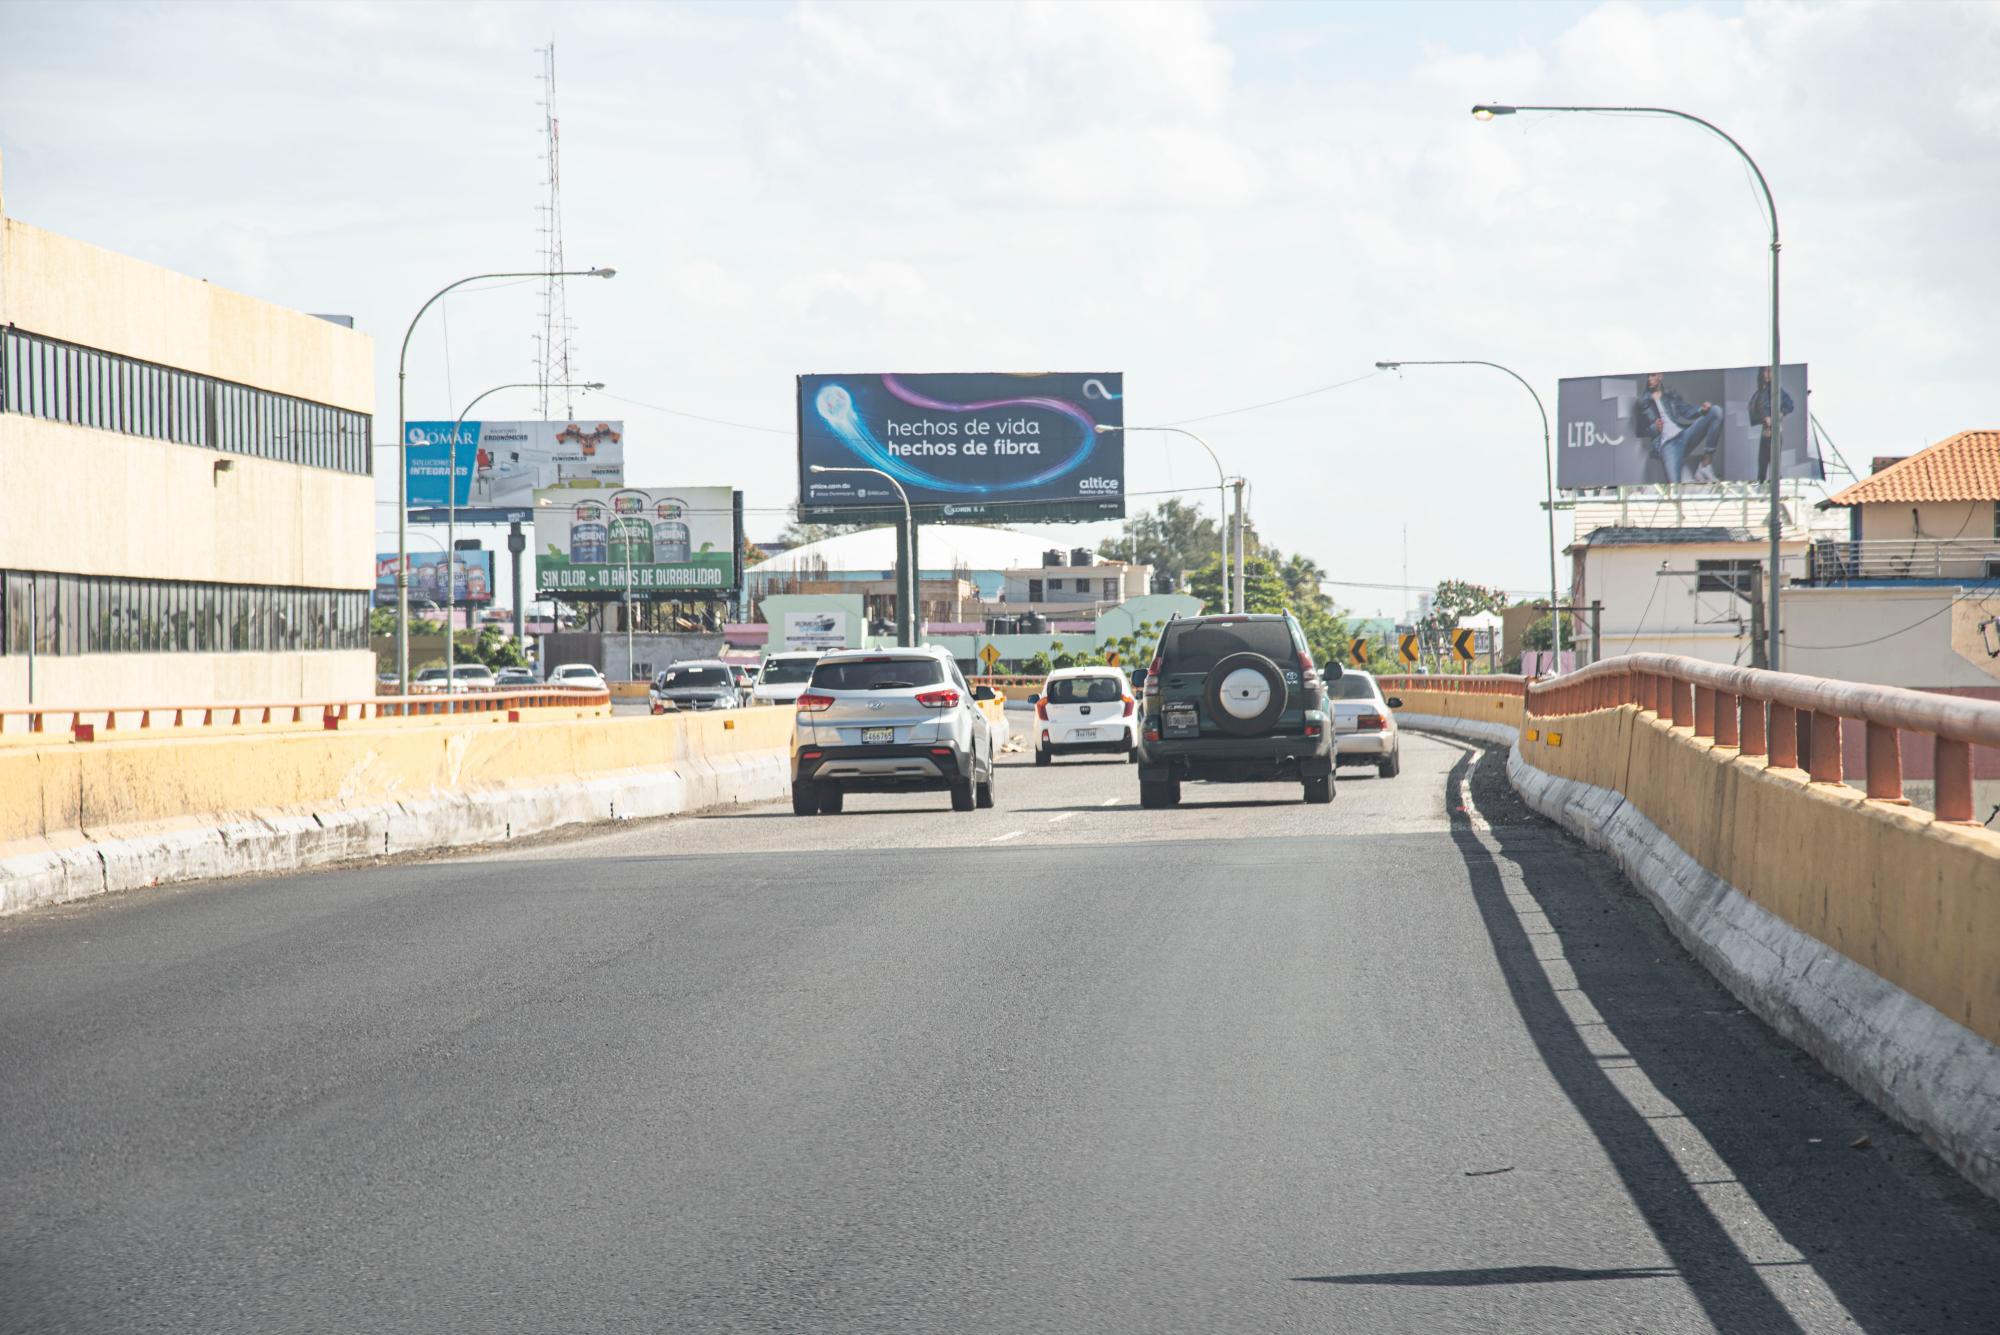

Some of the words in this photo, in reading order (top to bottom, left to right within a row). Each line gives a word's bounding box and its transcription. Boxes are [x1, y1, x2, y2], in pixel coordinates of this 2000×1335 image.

[887, 419, 958, 436] hechos
[964, 418, 990, 435] de
[996, 418, 1040, 435] vida
[1568, 421, 1595, 447] LTB
[426, 431, 473, 445] OMAR
[888, 440, 957, 456] hechos
[962, 439, 988, 455] de
[994, 438, 1040, 455] fibra
[412, 459, 452, 467] SOLUCIONE
[1079, 476, 1119, 490] altice
[542, 570, 559, 587] SIN
[561, 570, 587, 587] OLOR
[599, 569, 609, 586] 10
[612, 567, 639, 586] AÑOS
[642, 569, 654, 586] DE
[656, 568, 722, 586] DURABILIDAD
